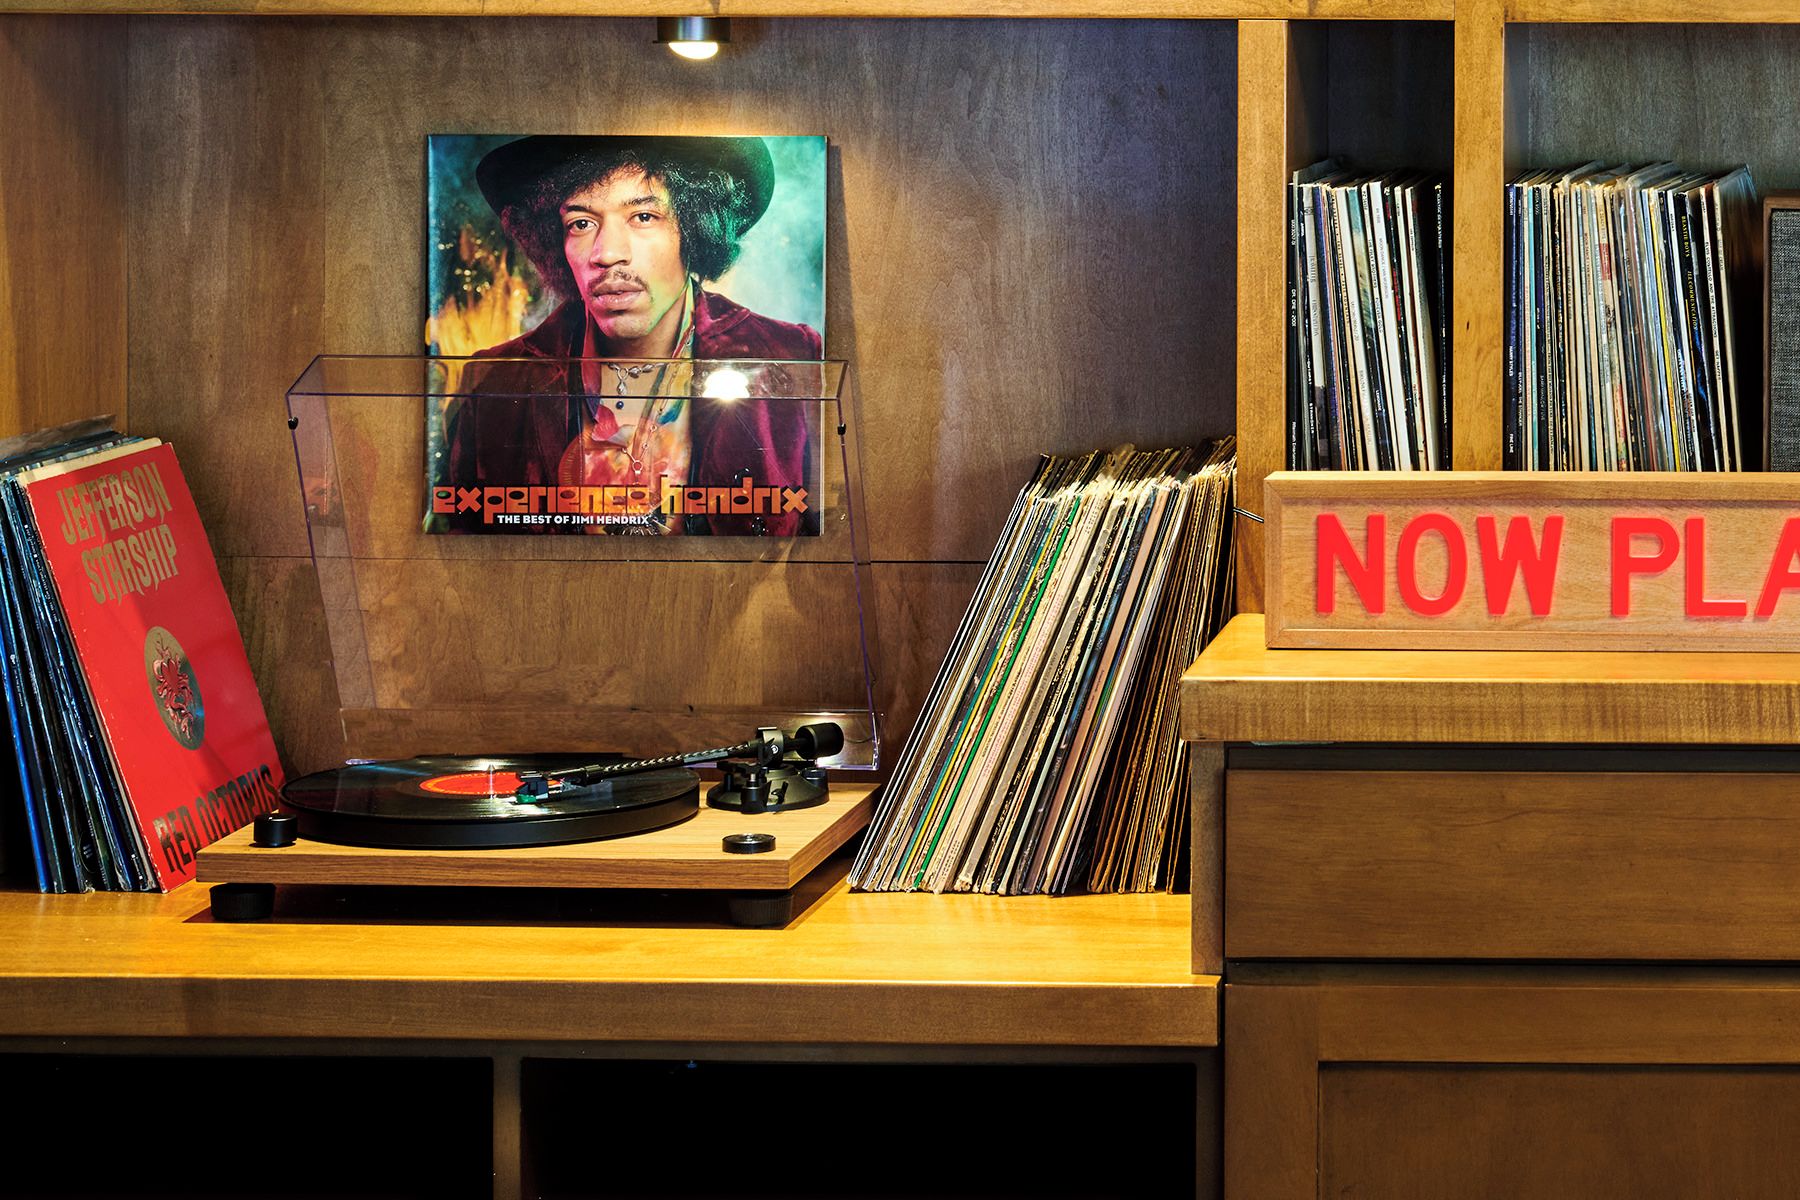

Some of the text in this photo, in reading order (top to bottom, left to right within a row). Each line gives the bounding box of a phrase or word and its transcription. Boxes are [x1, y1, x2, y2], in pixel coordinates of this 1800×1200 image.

[1688, 280, 1697, 330] COMMUNICATION
[56, 461, 173, 545] JEFFERSON
[432, 474, 808, 525] experience hendrix
[497, 514, 650, 525] THE BEST OF JIMI HENDRIX
[81, 522, 179, 607] STARSHIP
[1315, 512, 1564, 618] NOW
[153, 764, 278, 876] RED OCTOPUS
